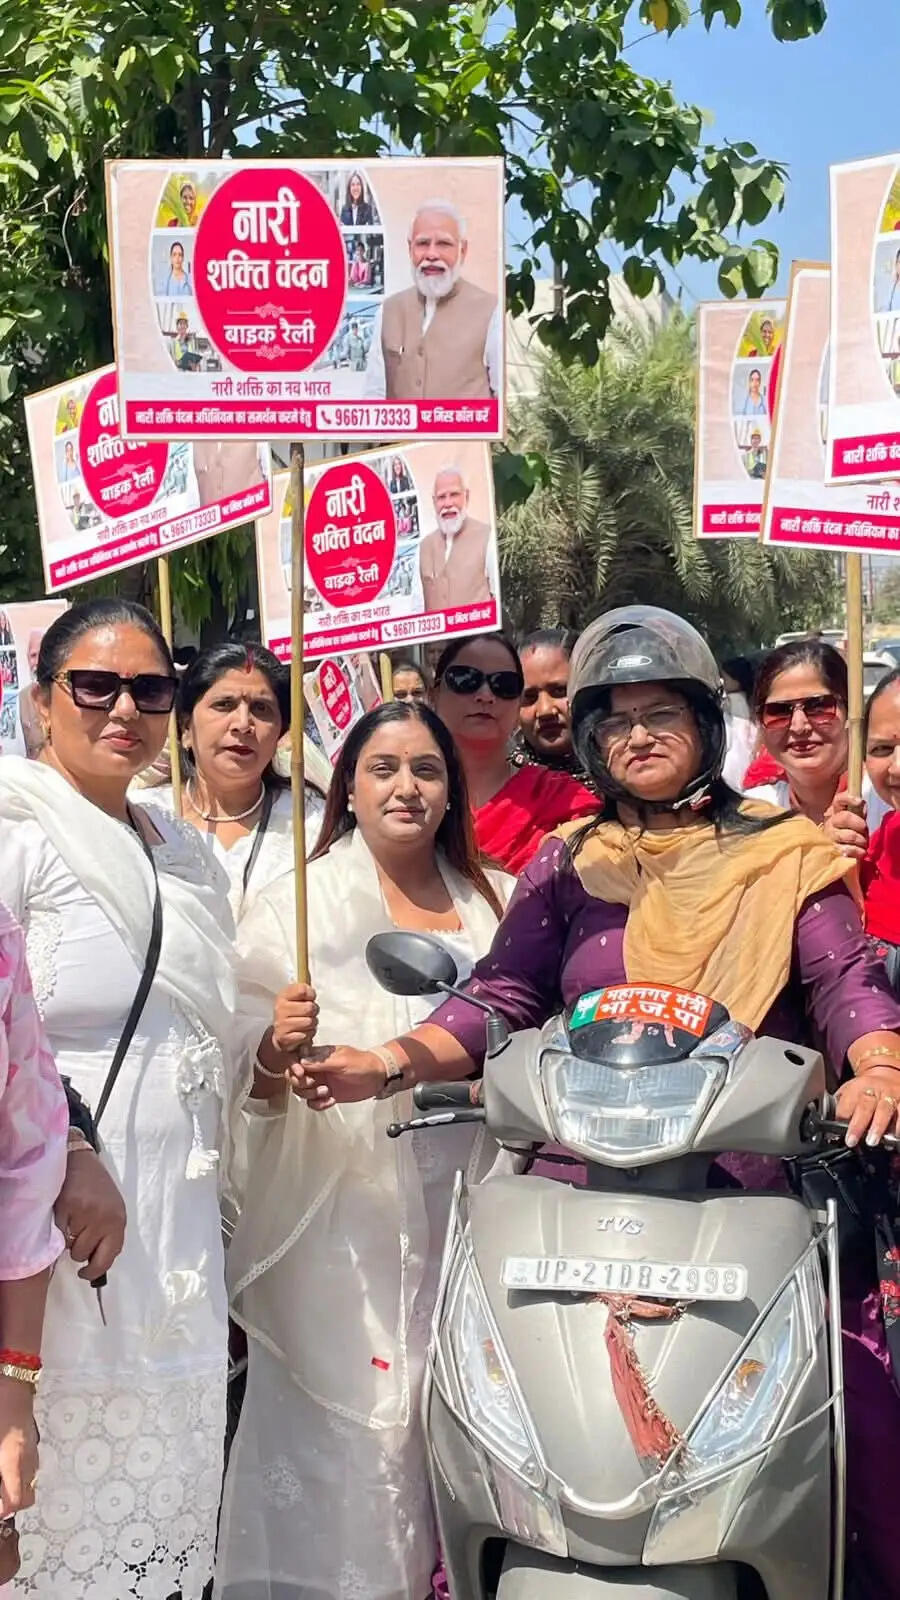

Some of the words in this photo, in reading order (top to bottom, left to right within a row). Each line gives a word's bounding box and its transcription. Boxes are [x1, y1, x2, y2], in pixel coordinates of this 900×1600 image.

[231, 186, 301, 246] नारी
[206, 248, 271, 292] शक्ति
[274, 248, 330, 292] वंदन
[223, 324, 277, 345] बाइक
[278, 317, 316, 344] रैली
[210, 376, 233, 396] नारी
[236, 377, 263, 396] शक्ति
[266, 381, 282, 396] का
[285, 381, 301, 395] नव
[304, 381, 331, 396] भारत
[135, 407, 153, 424] नारी
[155, 407, 174, 424] शक्ति
[335, 408, 370, 426] 96671
[374, 408, 411, 426] 73333
[842, 444, 865, 464] नारी
[865, 441, 888, 462] शक्ति
[325, 474, 367, 518] नारी
[866, 490, 891, 511] नारी
[312, 524, 350, 555] शक्ति
[353, 516, 386, 545] वंदन
[780, 516, 801, 532] नारी
[801, 516, 822, 533] शक्ति
[324, 570, 356, 590] बाइक
[357, 562, 380, 585] रैली
[607, 987, 672, 1001] महानगर
[676, 991, 708, 1015] मंत्री
[596, 1215, 644, 1235] TVS
